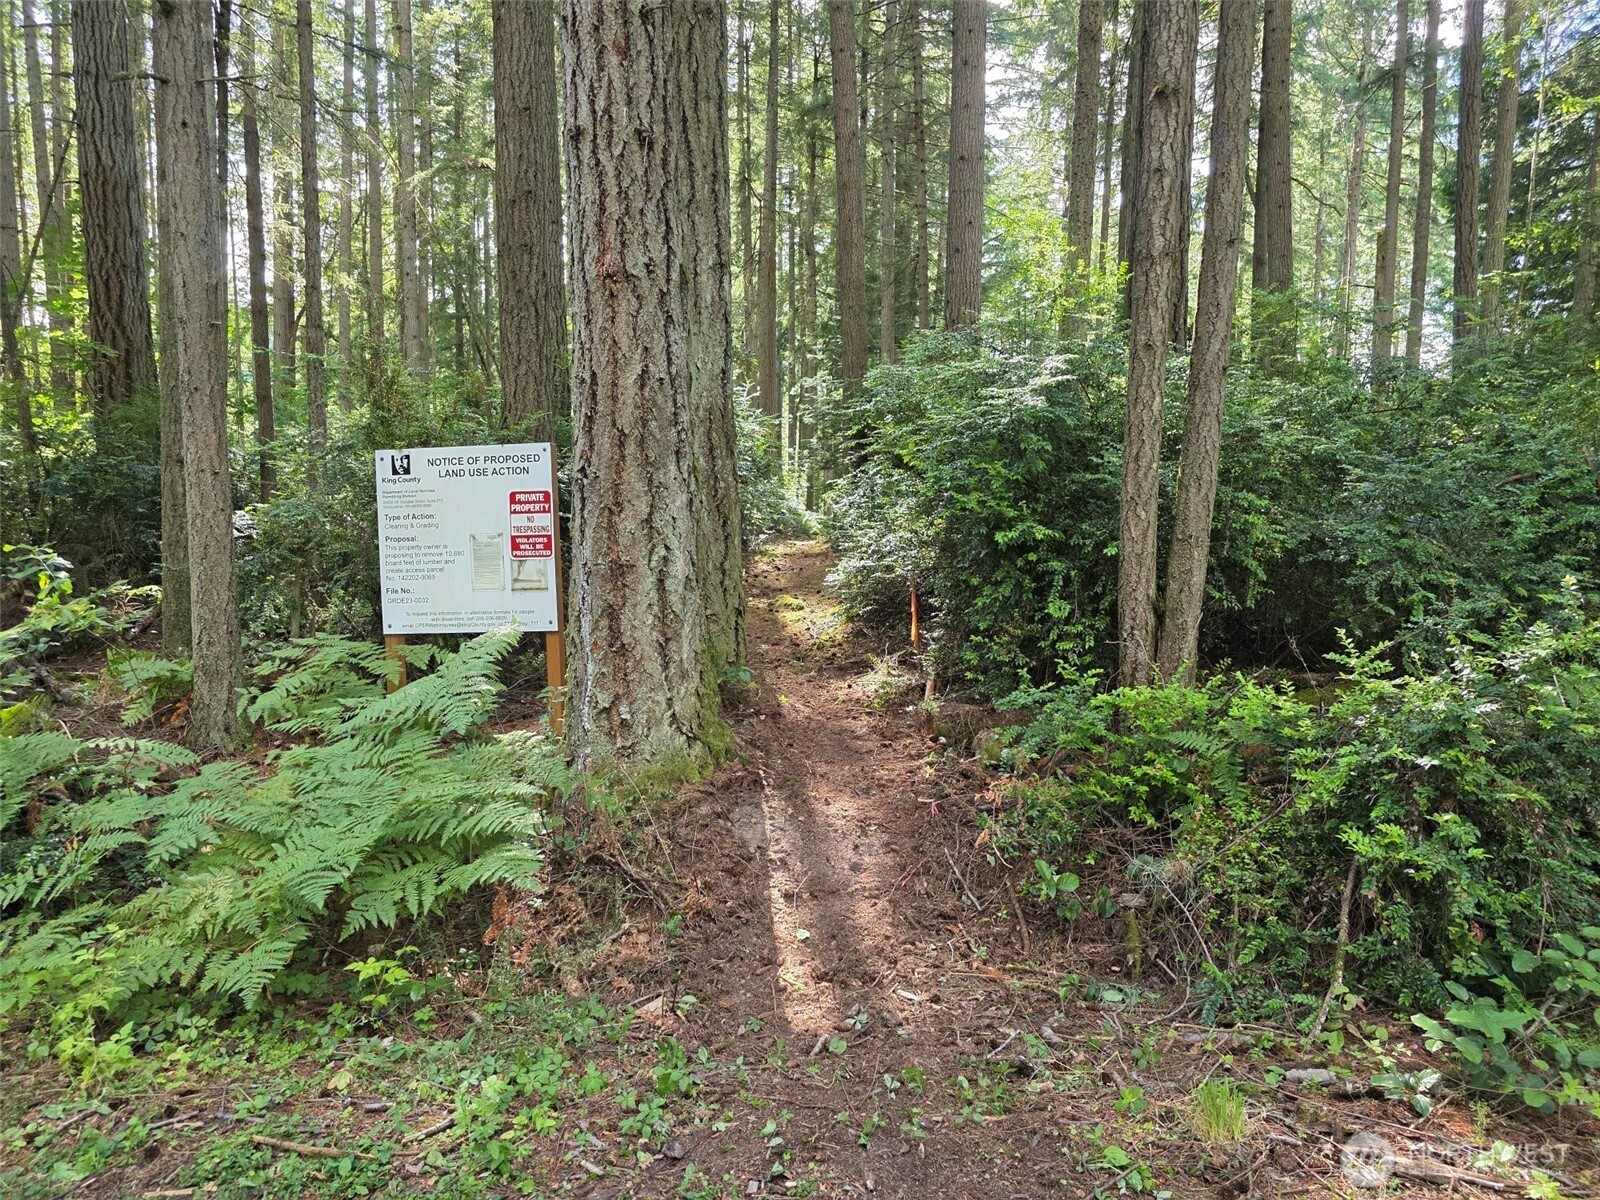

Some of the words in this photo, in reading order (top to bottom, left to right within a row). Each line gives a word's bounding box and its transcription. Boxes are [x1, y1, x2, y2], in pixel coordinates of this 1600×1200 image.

[428, 457, 464, 466] NOTICE
[467, 456, 480, 465] OF
[484, 454, 540, 464] PROPOSED
[438, 469, 465, 478] LAND
[469, 468, 488, 476] USE
[492, 466, 530, 476] ACTION
[516, 493, 544, 502] PRIVATE
[511, 503, 549, 512] PROPERTY
[384, 514, 401, 522] Type
